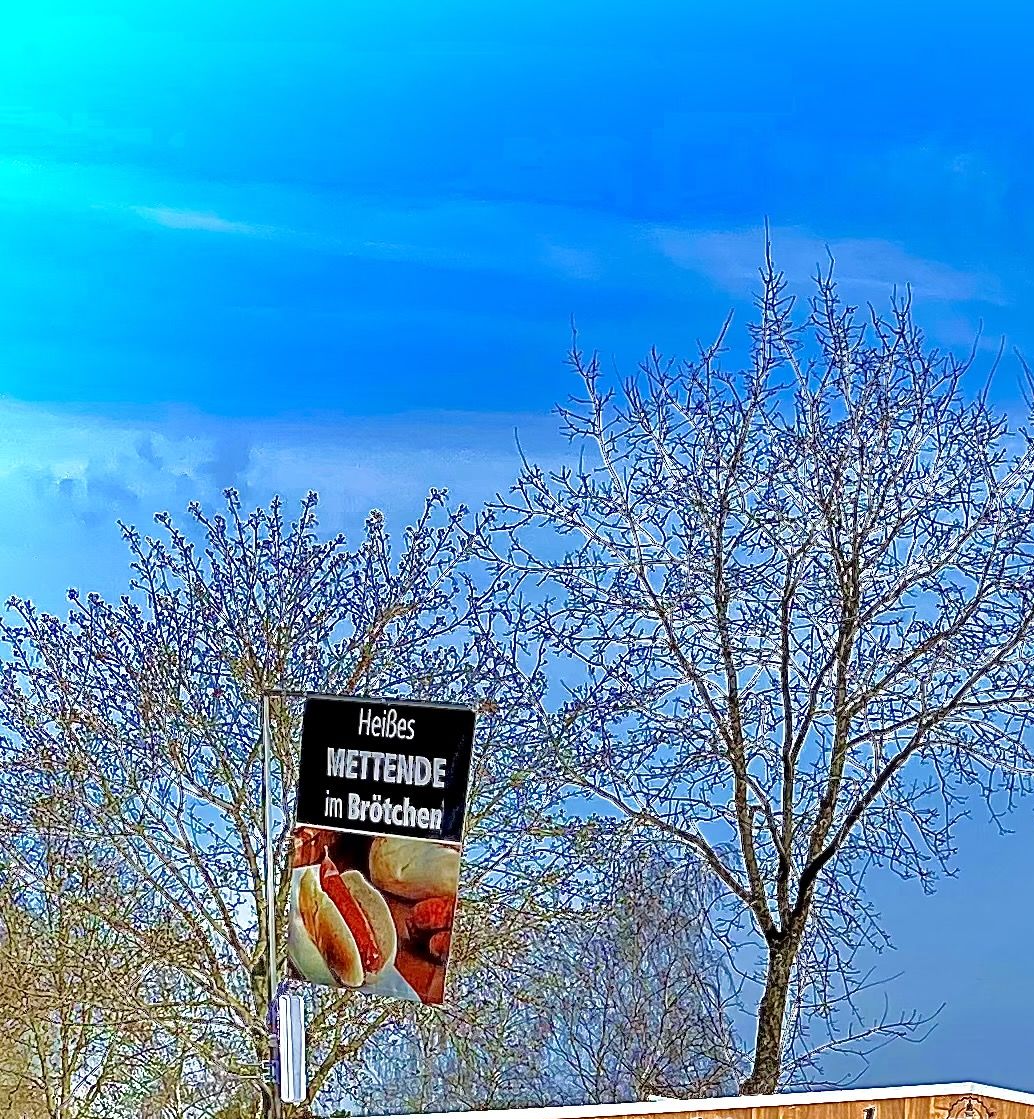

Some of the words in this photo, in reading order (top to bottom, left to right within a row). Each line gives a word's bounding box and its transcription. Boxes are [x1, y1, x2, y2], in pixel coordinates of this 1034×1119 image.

[358, 707, 415, 740] Heißes
[326, 747, 447, 788] METTENDE
[324, 790, 343, 818] im
[347, 793, 443, 829] Brötchen
